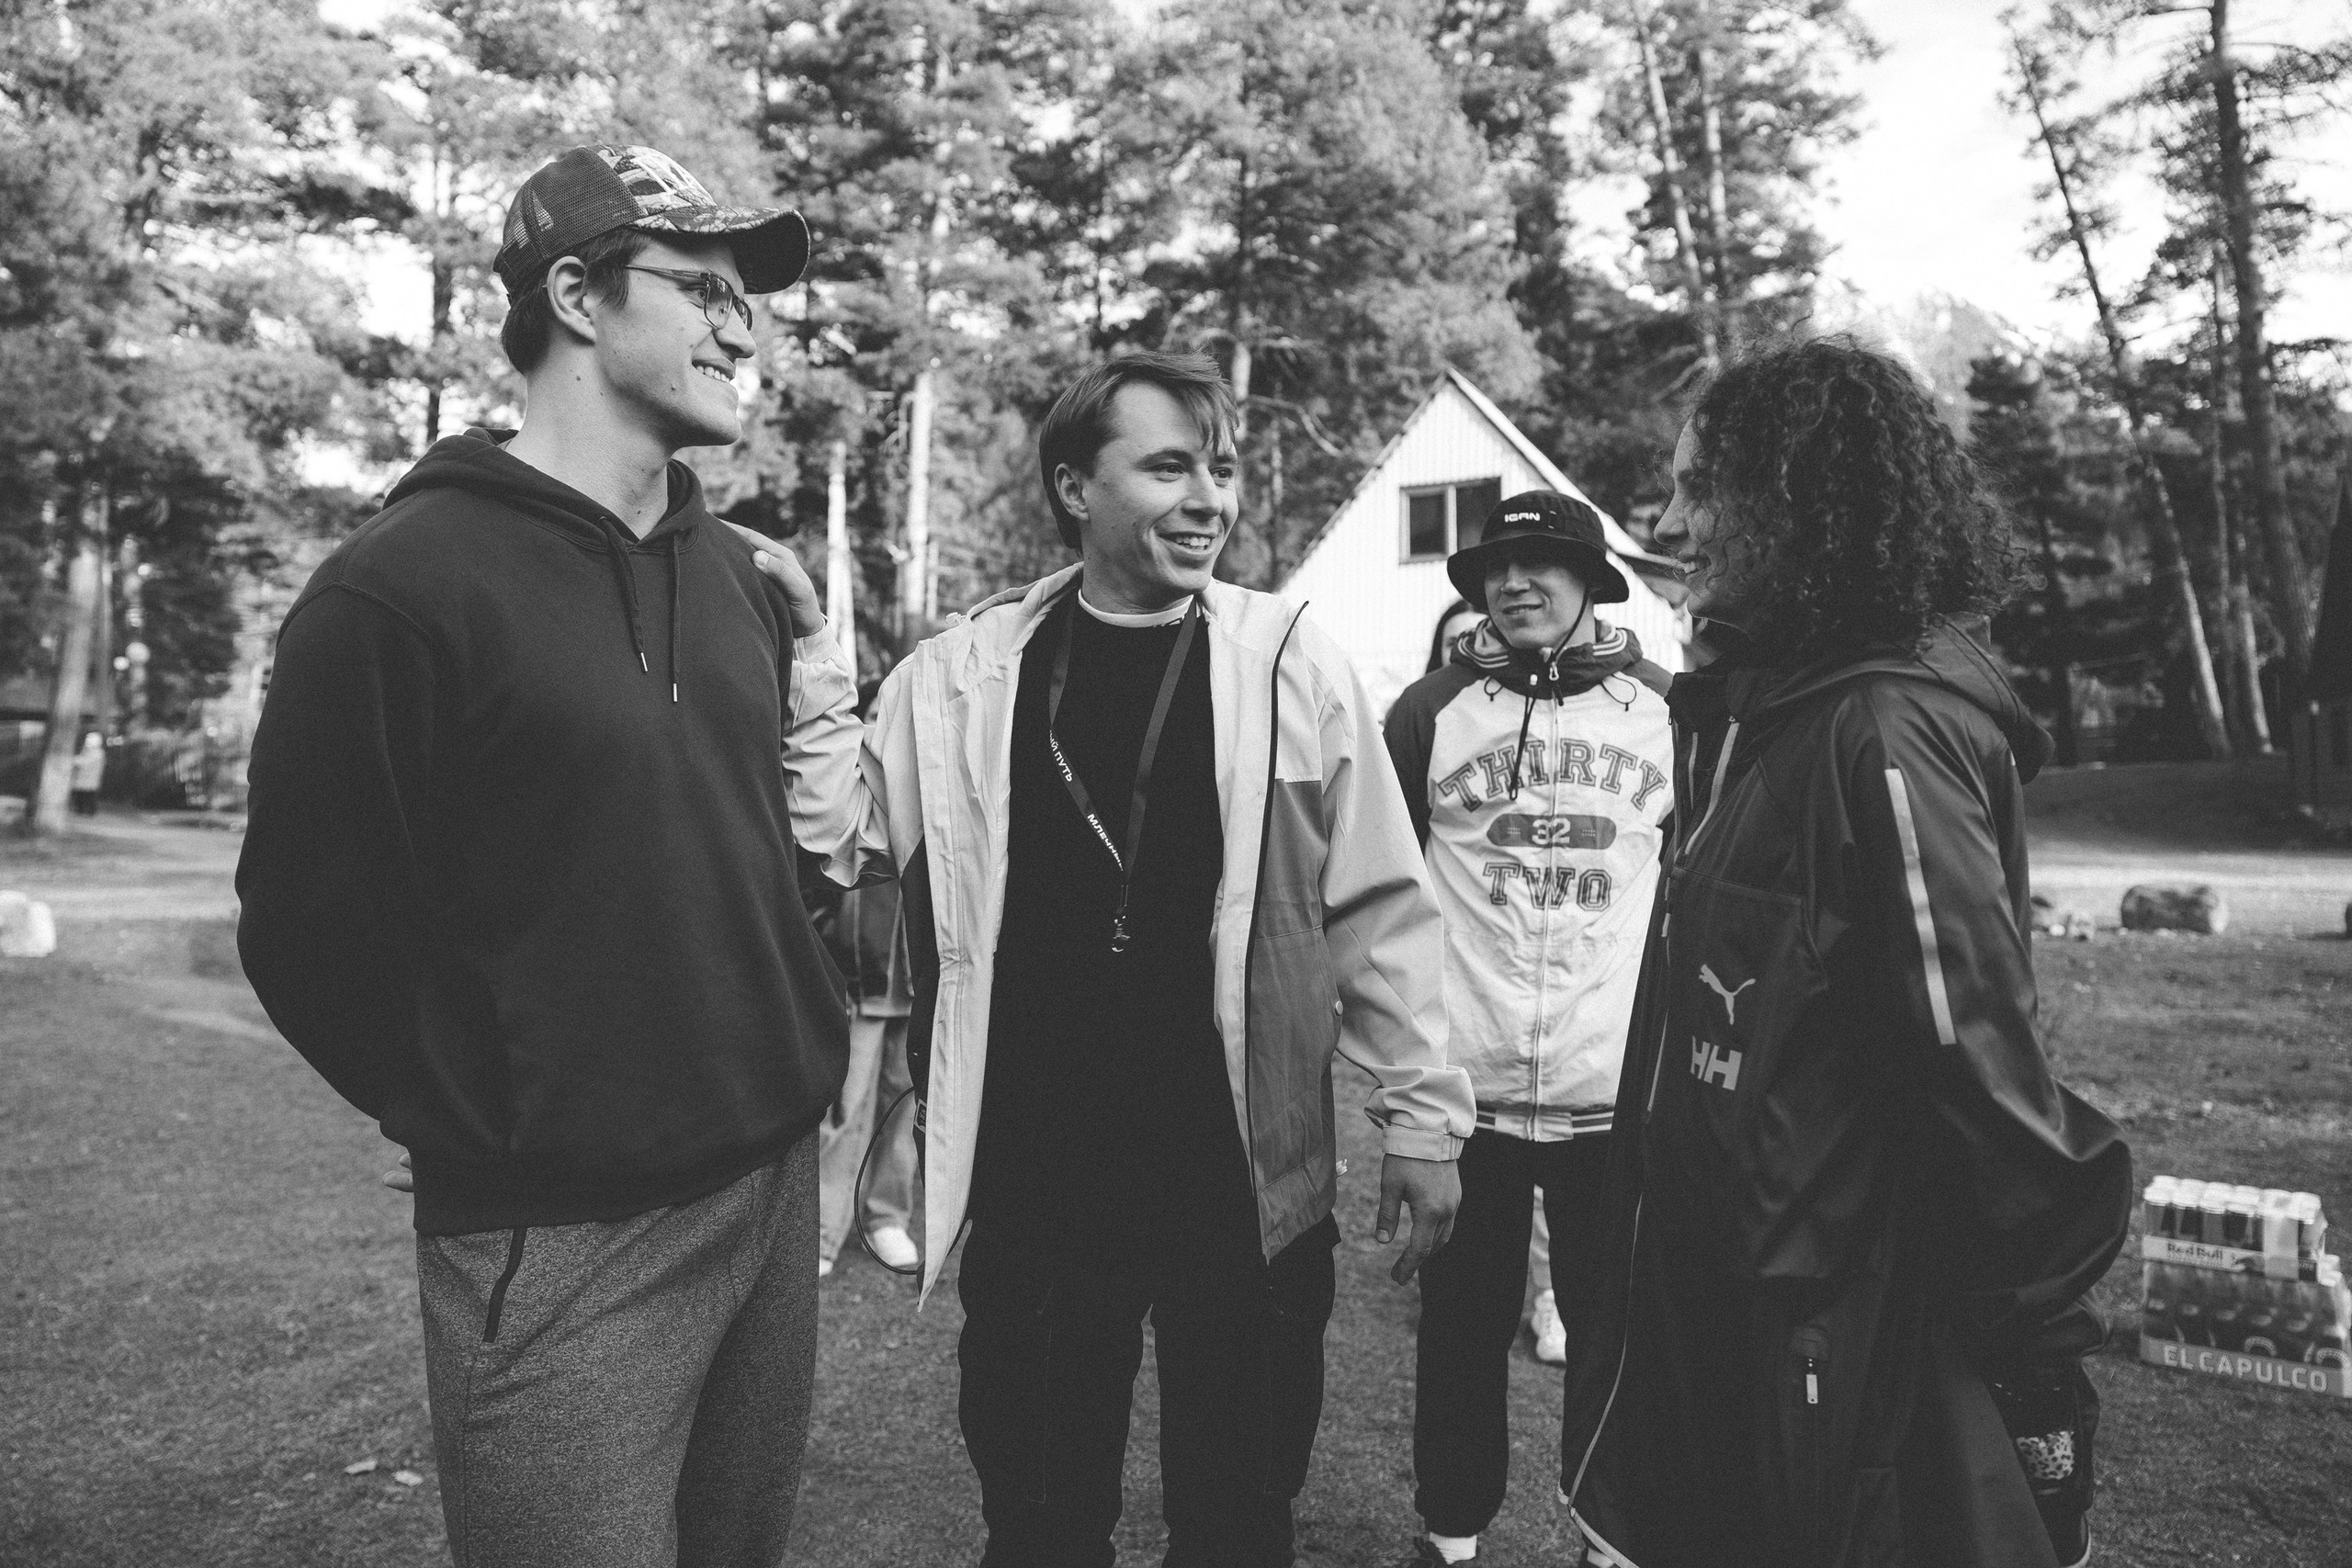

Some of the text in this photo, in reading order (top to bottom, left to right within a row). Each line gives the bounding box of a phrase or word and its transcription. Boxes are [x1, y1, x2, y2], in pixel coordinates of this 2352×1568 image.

[1055, 750, 1072, 782] ПУТЬ
[1438, 738, 1668, 812] THIRTY
[1532, 818, 1571, 845] 32
[1483, 862, 1612, 912] TWO
[2167, 1242, 2224, 1260] Red Bull
